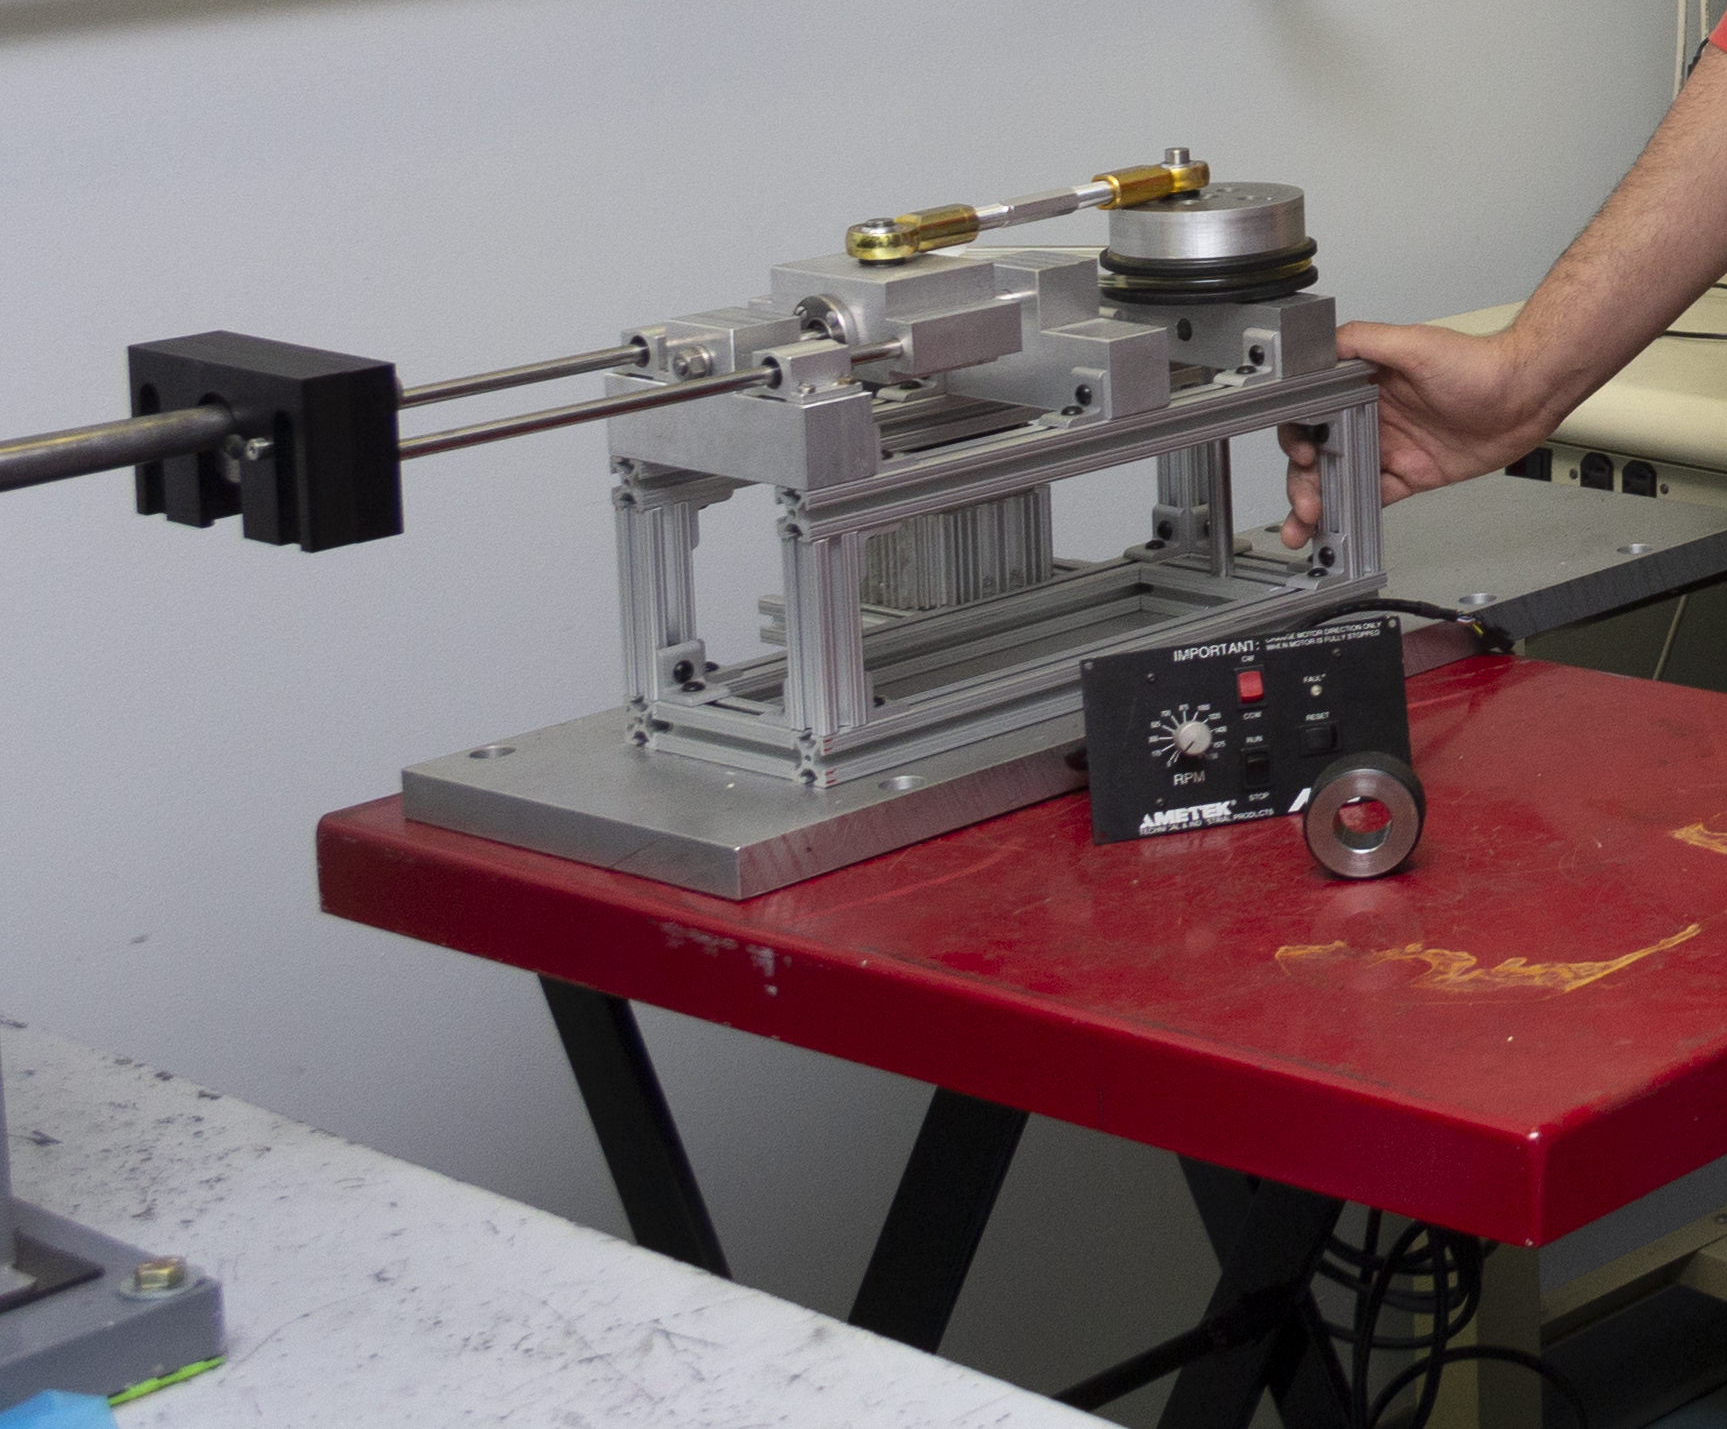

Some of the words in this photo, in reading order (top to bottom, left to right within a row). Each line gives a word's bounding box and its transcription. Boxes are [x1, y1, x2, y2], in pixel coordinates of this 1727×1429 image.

[1289, 638, 1315, 648] MOTOR
[1324, 634, 1345, 642] FULLY
[1347, 629, 1381, 640] STOPPED
[1296, 629, 1323, 640] MOTOR
[1324, 624, 1362, 635] DIRECTION
[1363, 621, 1382, 630] ONLY
[1306, 711, 1330, 721] RESET
[1173, 770, 1206, 787] RPM
[1248, 792, 1270, 801] STOP
[1139, 800, 1232, 829] AMETEK
[1232, 807, 1275, 821] PRODUCTS
